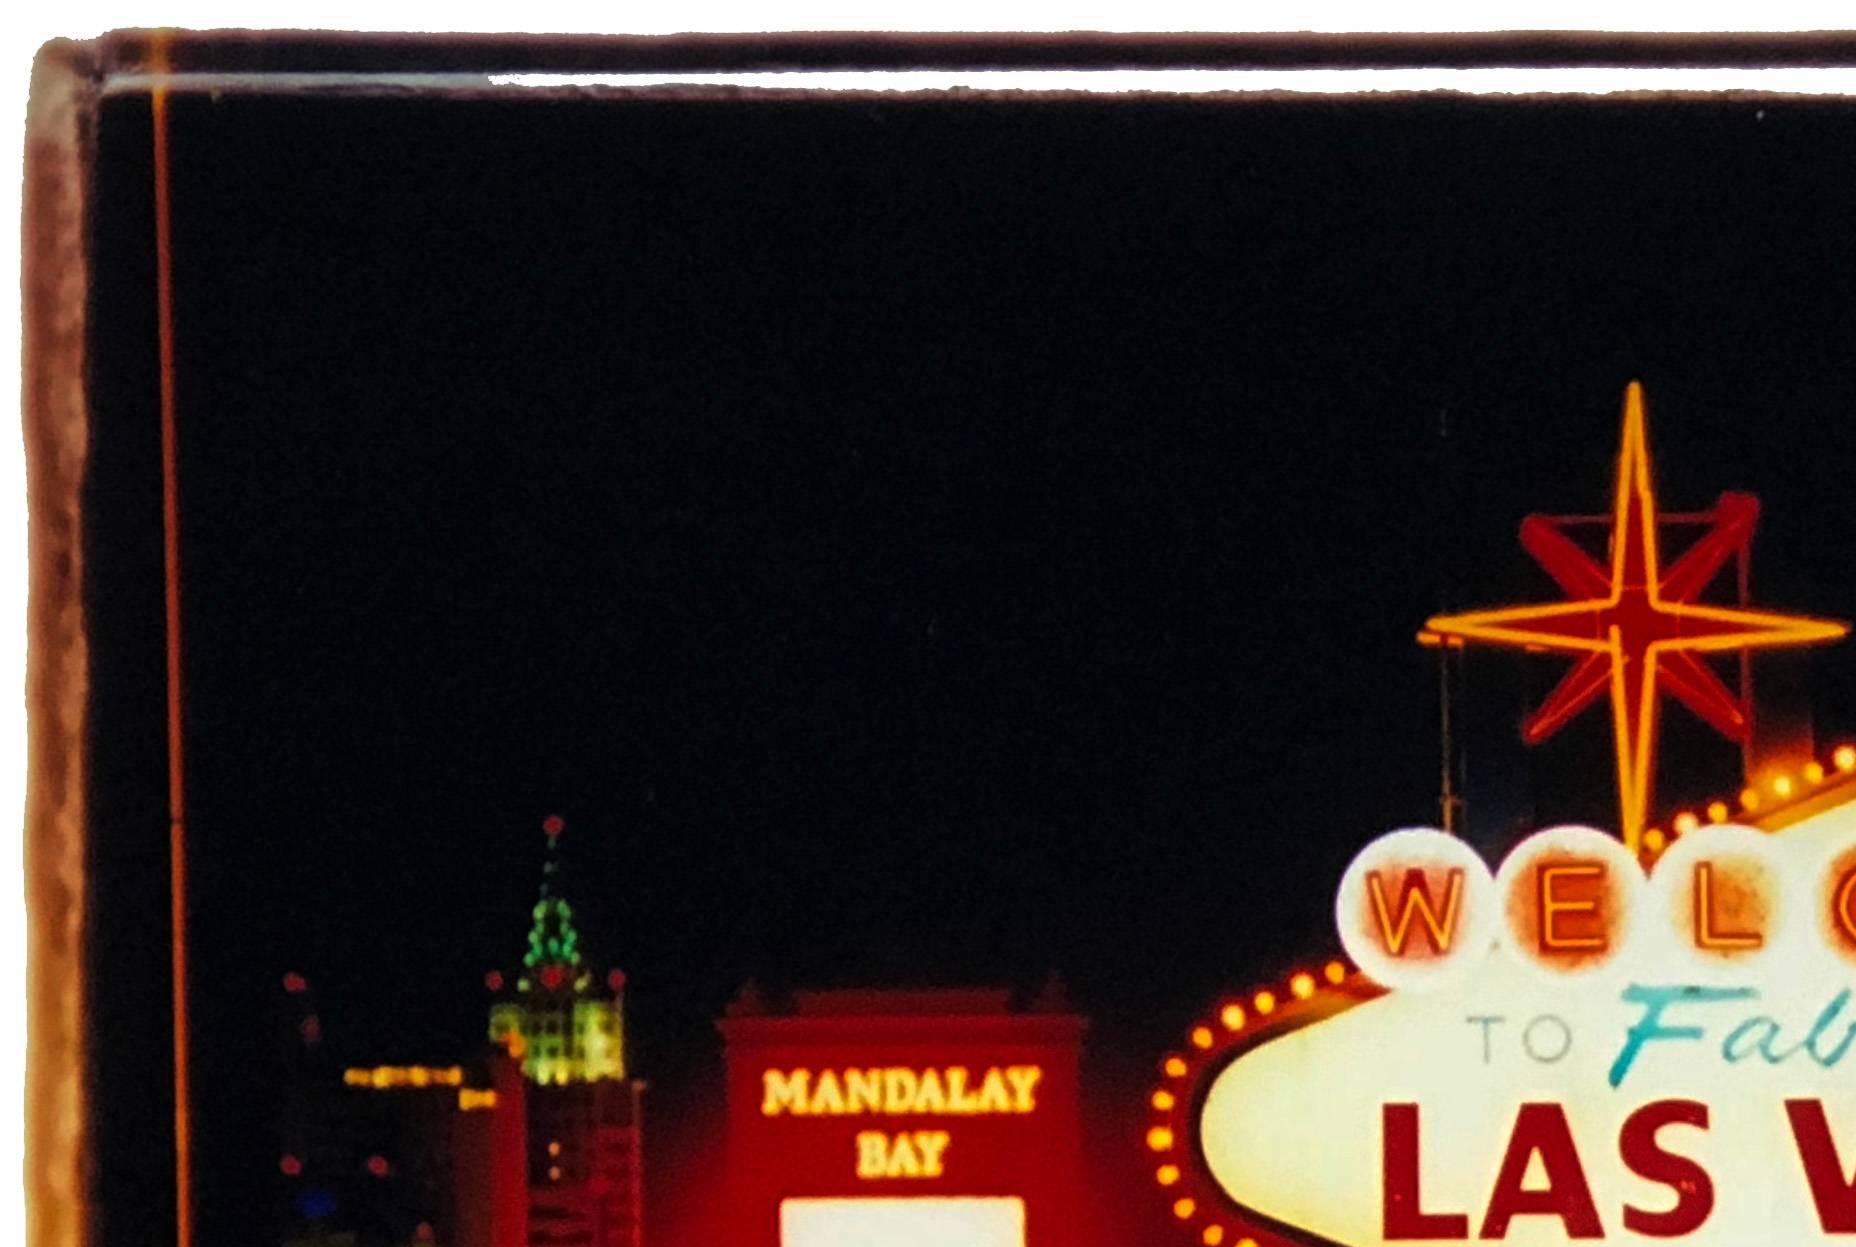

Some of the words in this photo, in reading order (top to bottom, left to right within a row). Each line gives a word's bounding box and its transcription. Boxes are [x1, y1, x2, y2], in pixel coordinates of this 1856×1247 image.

[1466, 1016, 1571, 1064] TO
[763, 1067, 1042, 1115] MANDALAY
[856, 1132, 950, 1178] BAY
[1382, 1099, 1716, 1241] LAS
